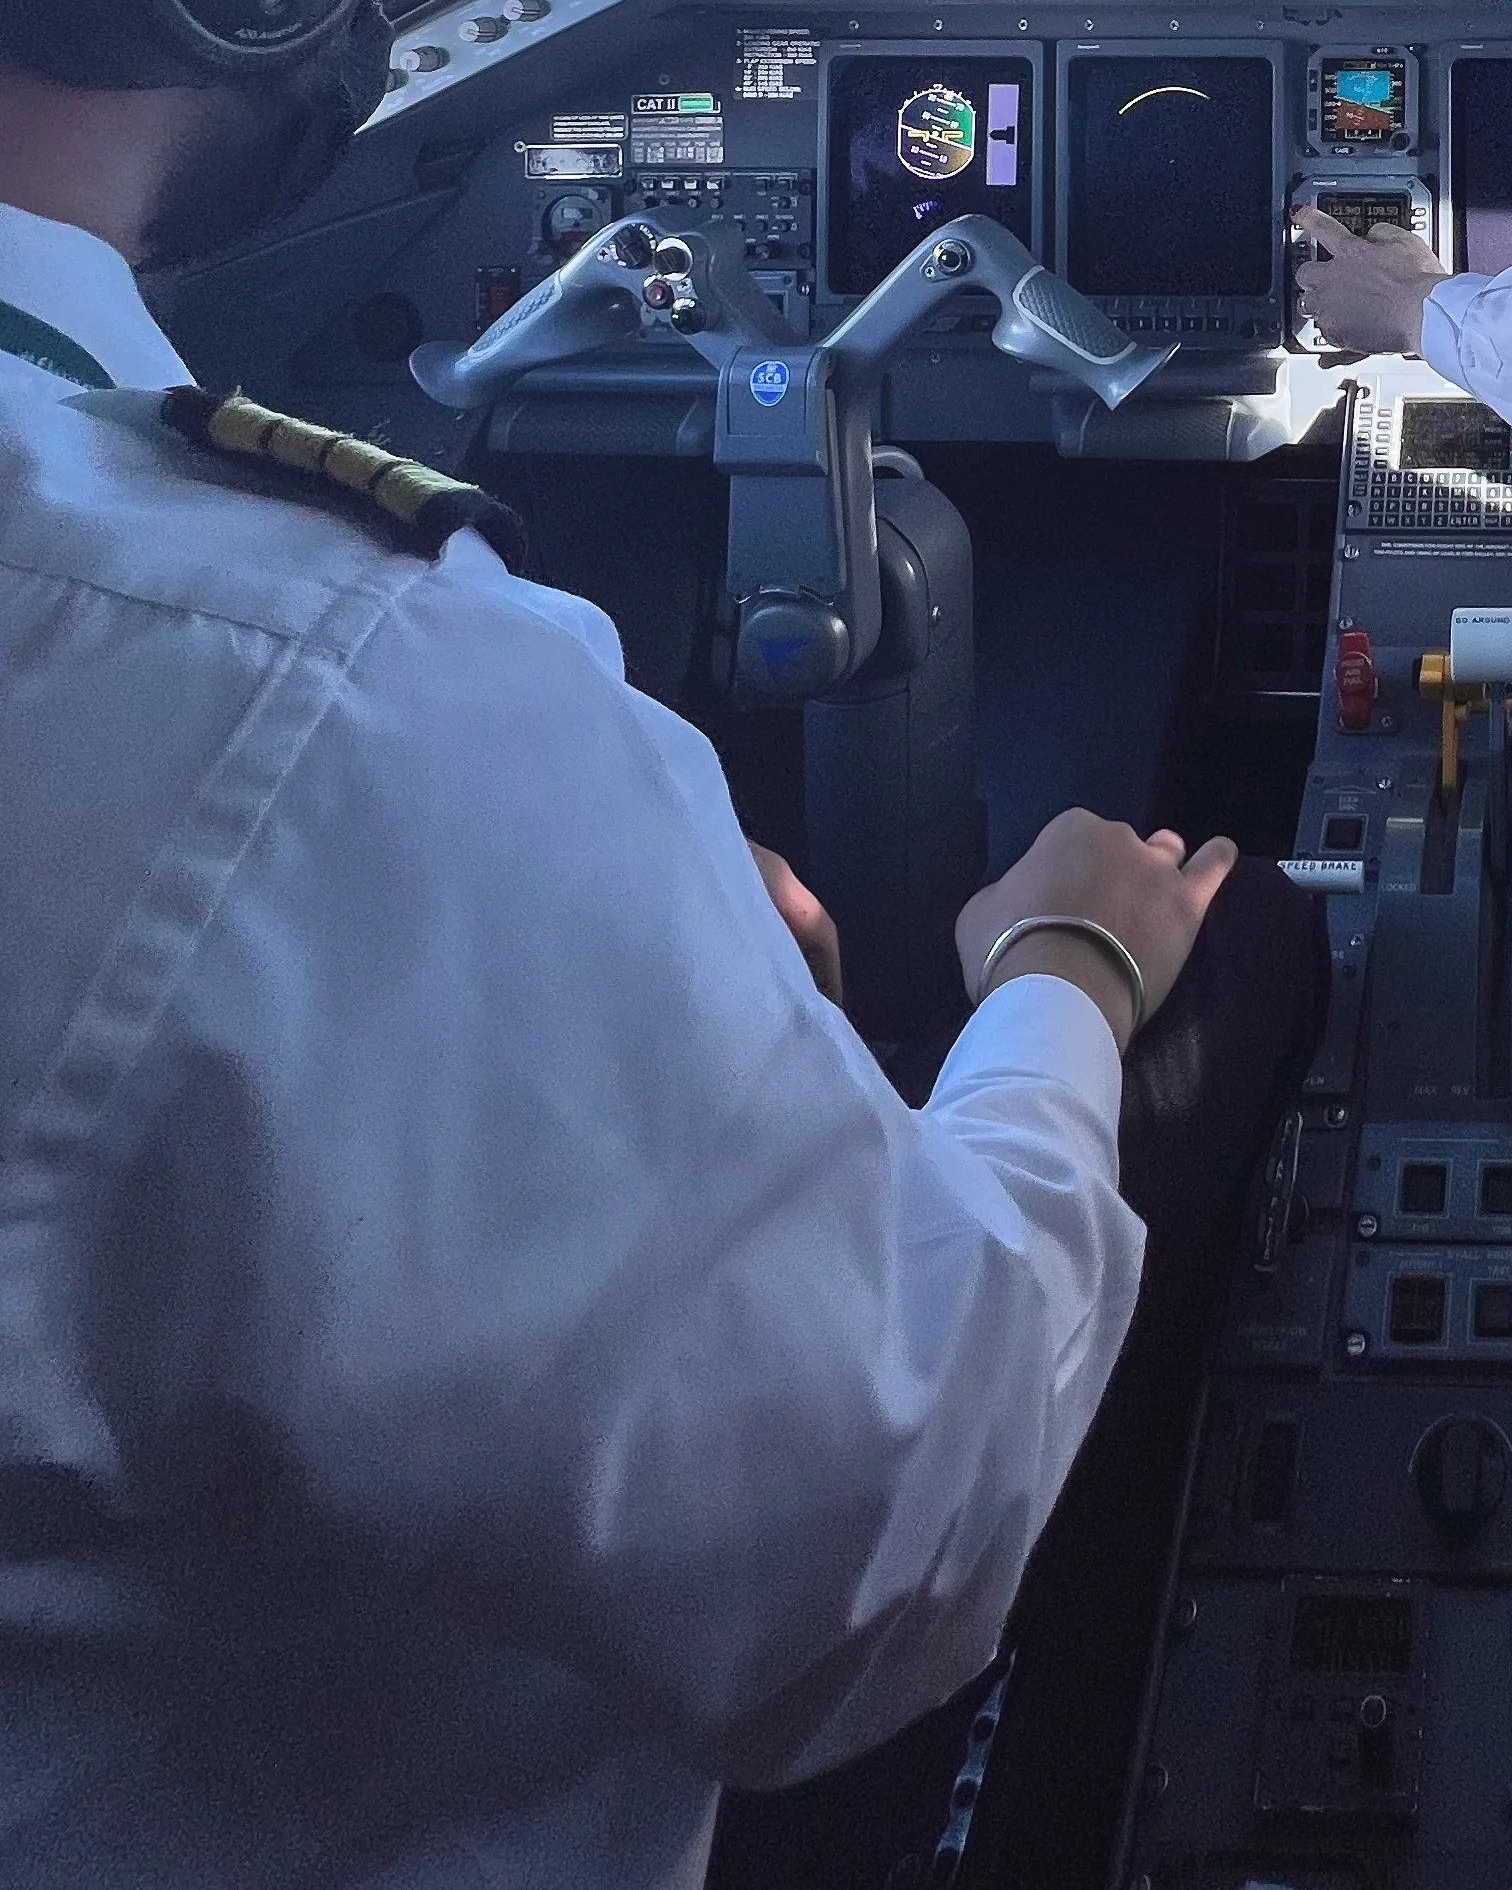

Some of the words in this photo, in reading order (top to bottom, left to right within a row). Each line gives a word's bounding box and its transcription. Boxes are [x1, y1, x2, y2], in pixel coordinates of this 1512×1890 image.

[637, 98, 664, 110] CAT
[666, 98, 676, 110] II
[1320, 860, 1358, 872] BRAKE
[1380, 882, 1417, 893] LOCKED
